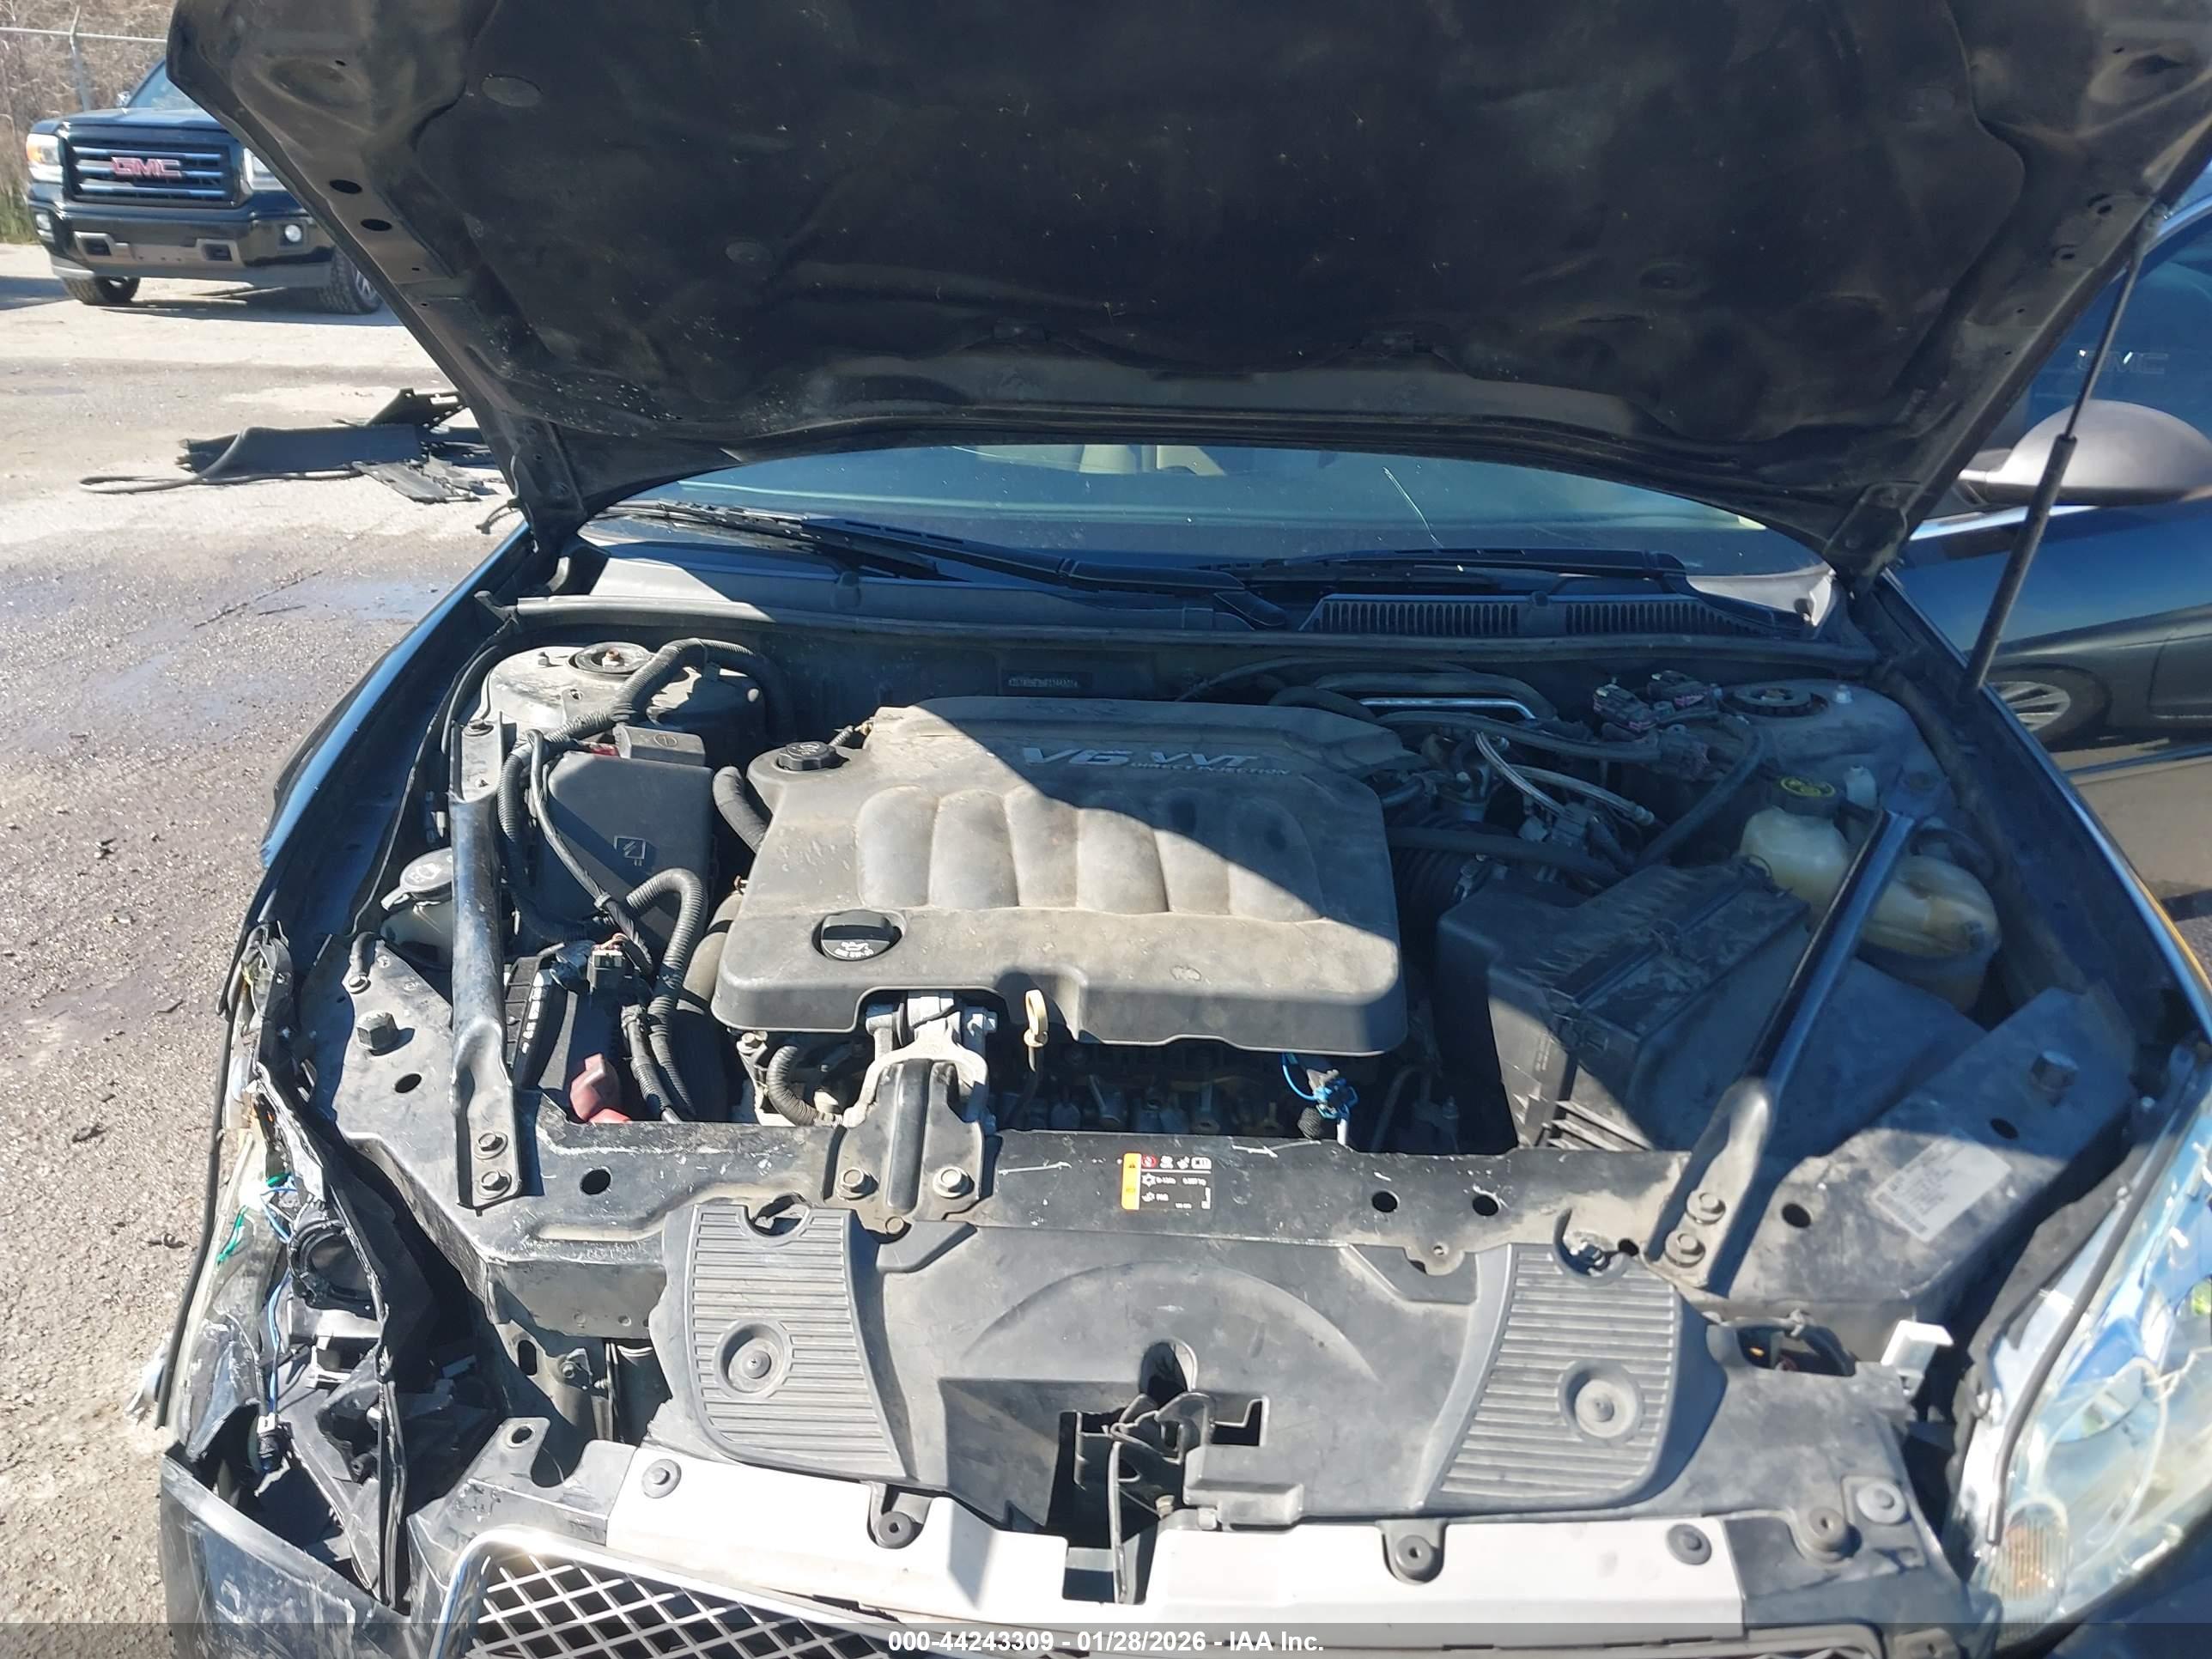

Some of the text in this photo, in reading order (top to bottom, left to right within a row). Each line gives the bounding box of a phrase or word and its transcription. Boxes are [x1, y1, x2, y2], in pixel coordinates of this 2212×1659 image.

[111, 157, 182, 179] GMC
[1023, 746, 1259, 768] V6 VVT
